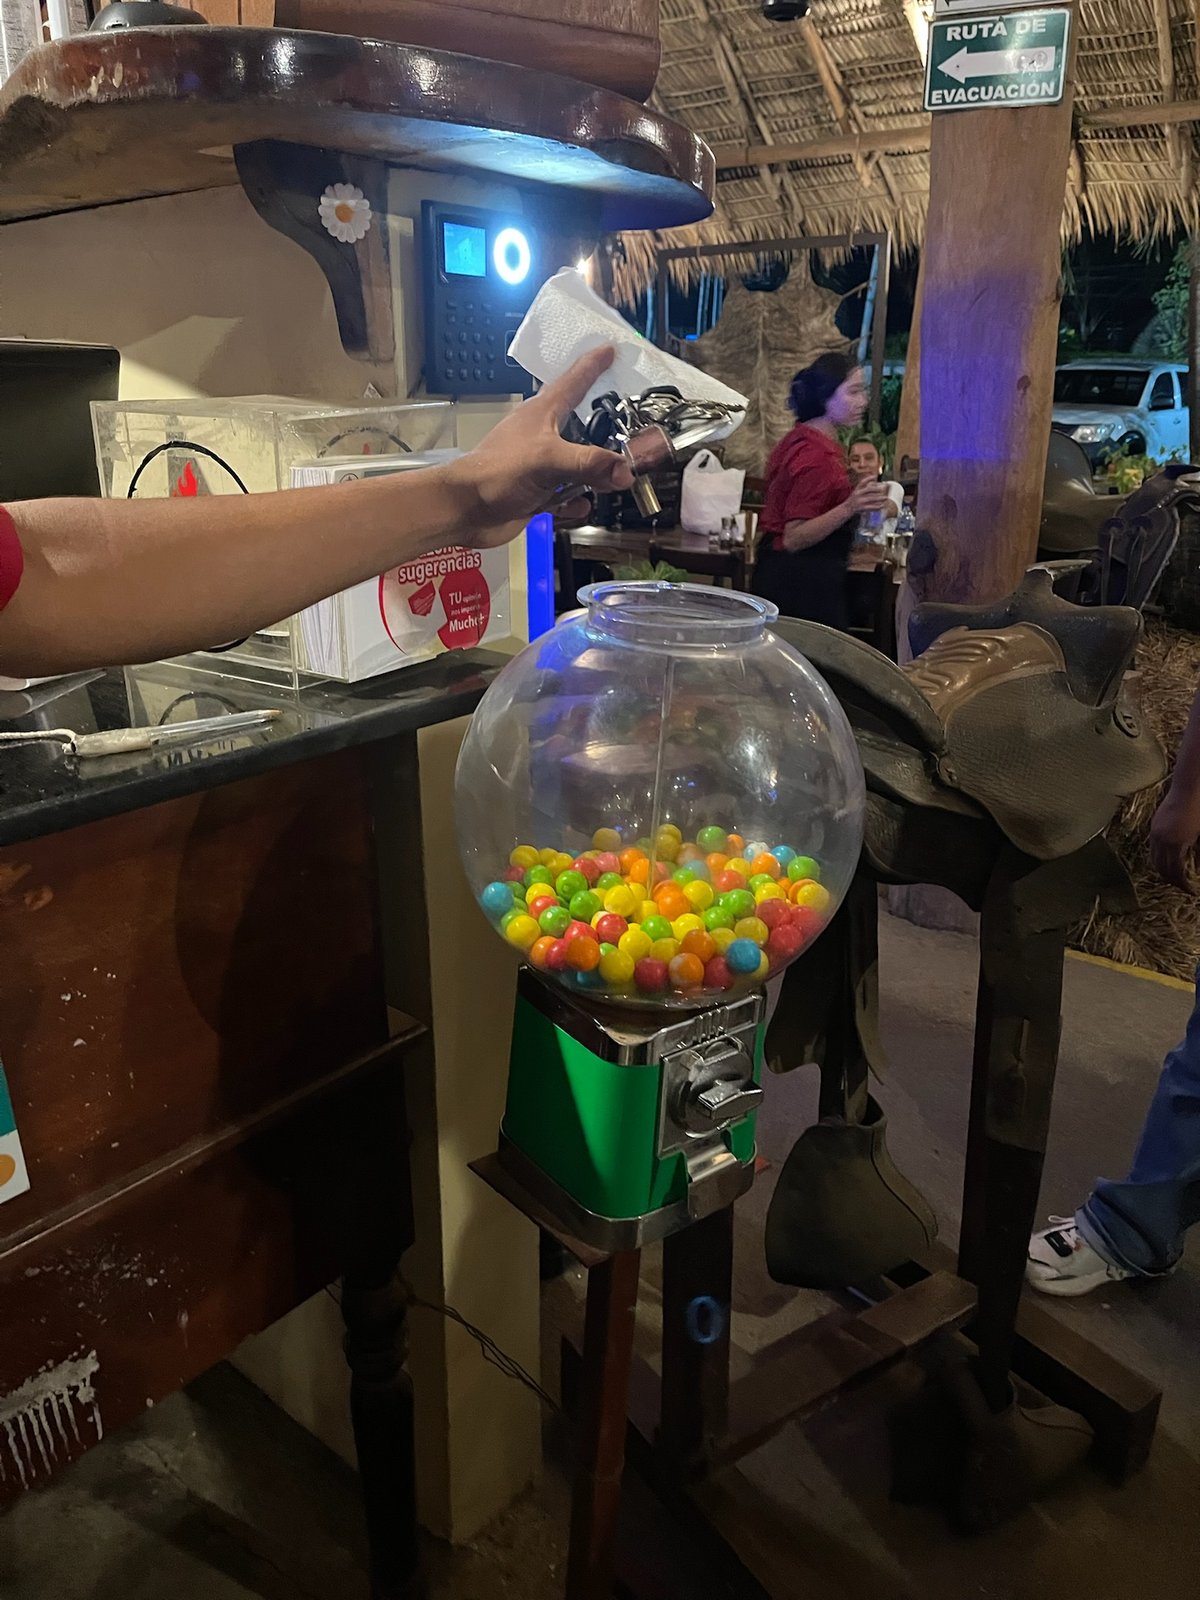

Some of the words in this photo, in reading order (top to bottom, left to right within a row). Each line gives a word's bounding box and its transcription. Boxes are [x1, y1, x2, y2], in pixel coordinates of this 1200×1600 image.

[946, 21, 1008, 42] RUTA
[1015, 18, 1047, 34] DE
[931, 80, 1055, 105] EVACUACIÓN
[399, 553, 481, 583] sugerencias
[448, 591, 462, 606] TU
